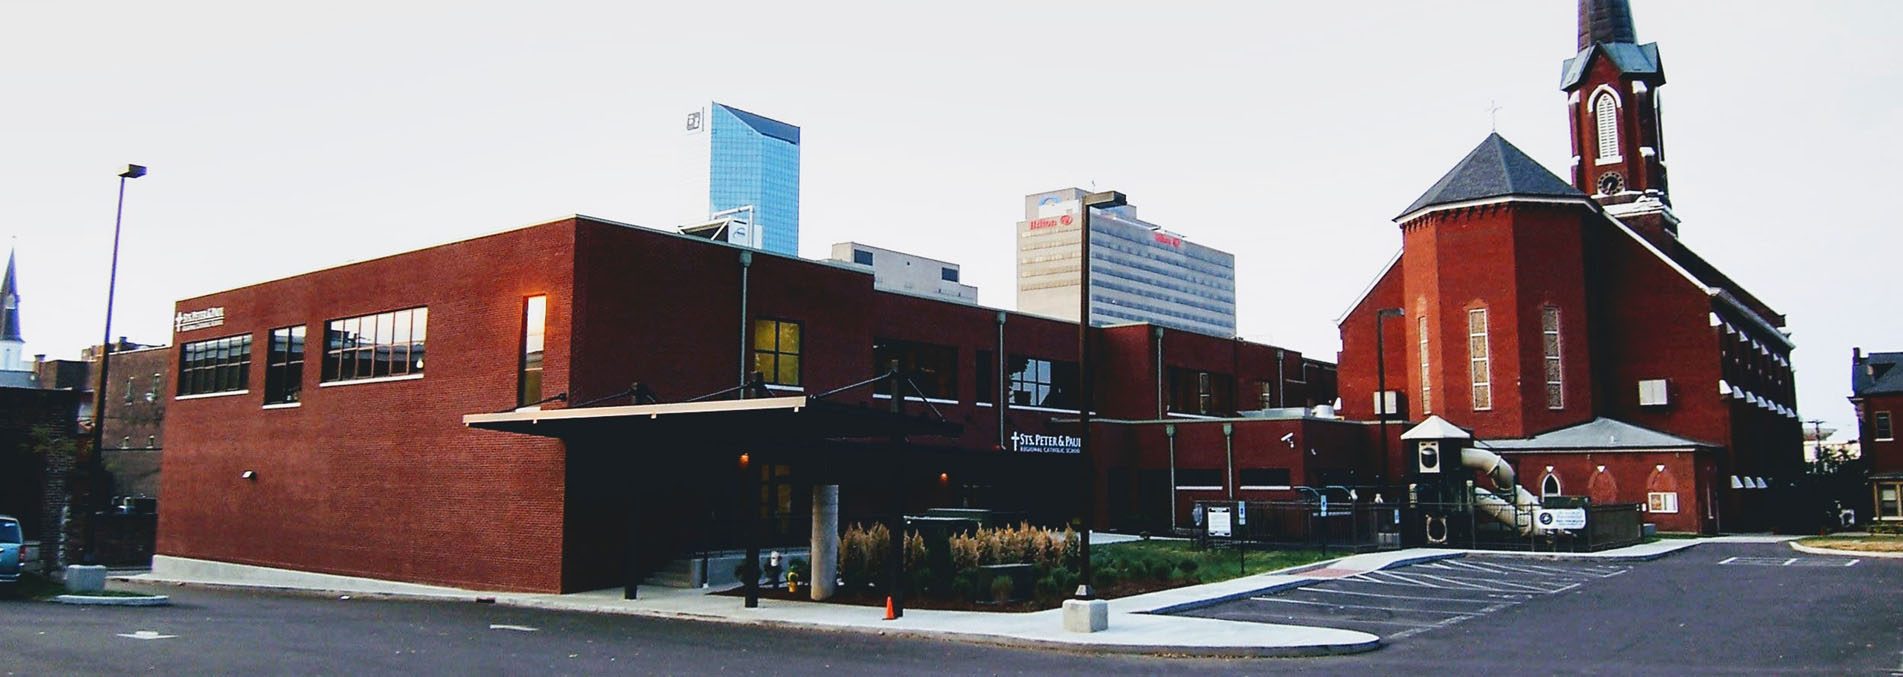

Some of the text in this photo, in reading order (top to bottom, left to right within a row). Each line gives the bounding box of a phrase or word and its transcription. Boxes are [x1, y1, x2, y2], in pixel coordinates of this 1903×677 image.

[1030, 219, 1057, 230] Hilton
[1035, 434, 1058, 447] PETER
[1058, 435, 1065, 447] &
